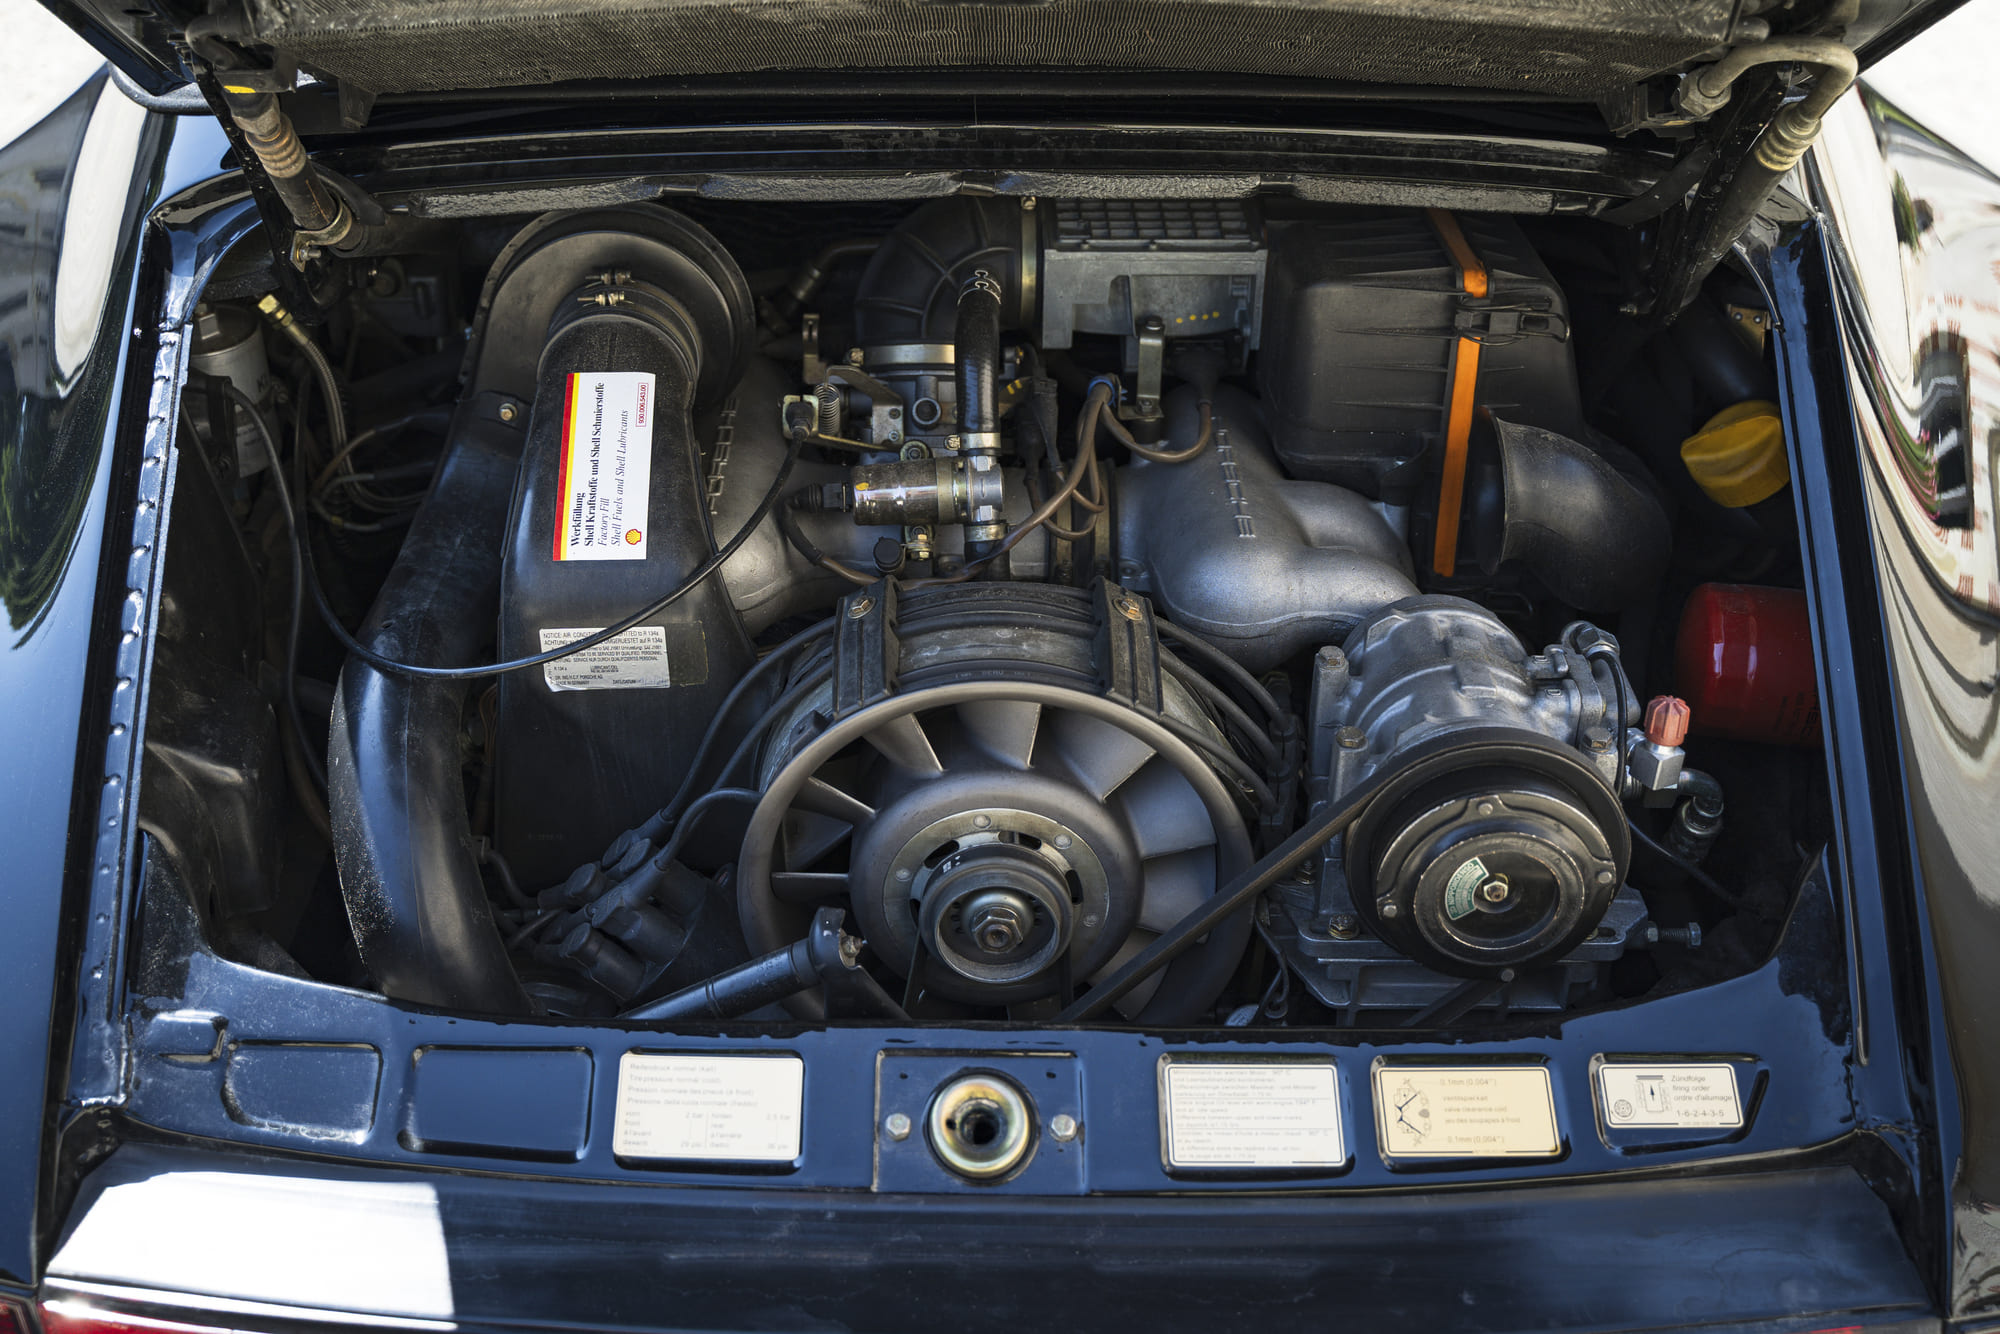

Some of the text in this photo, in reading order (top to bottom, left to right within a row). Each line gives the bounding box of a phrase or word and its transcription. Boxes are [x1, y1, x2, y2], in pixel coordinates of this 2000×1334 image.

[584, 382, 605, 546] Shell Kraftstoffe und Shell Schmierstoffe
[611, 410, 629, 546] Shell Fuels and Shell Lubricants
[571, 493, 585, 547] Werkfüllung
[598, 498, 610, 546] Factory Fill
